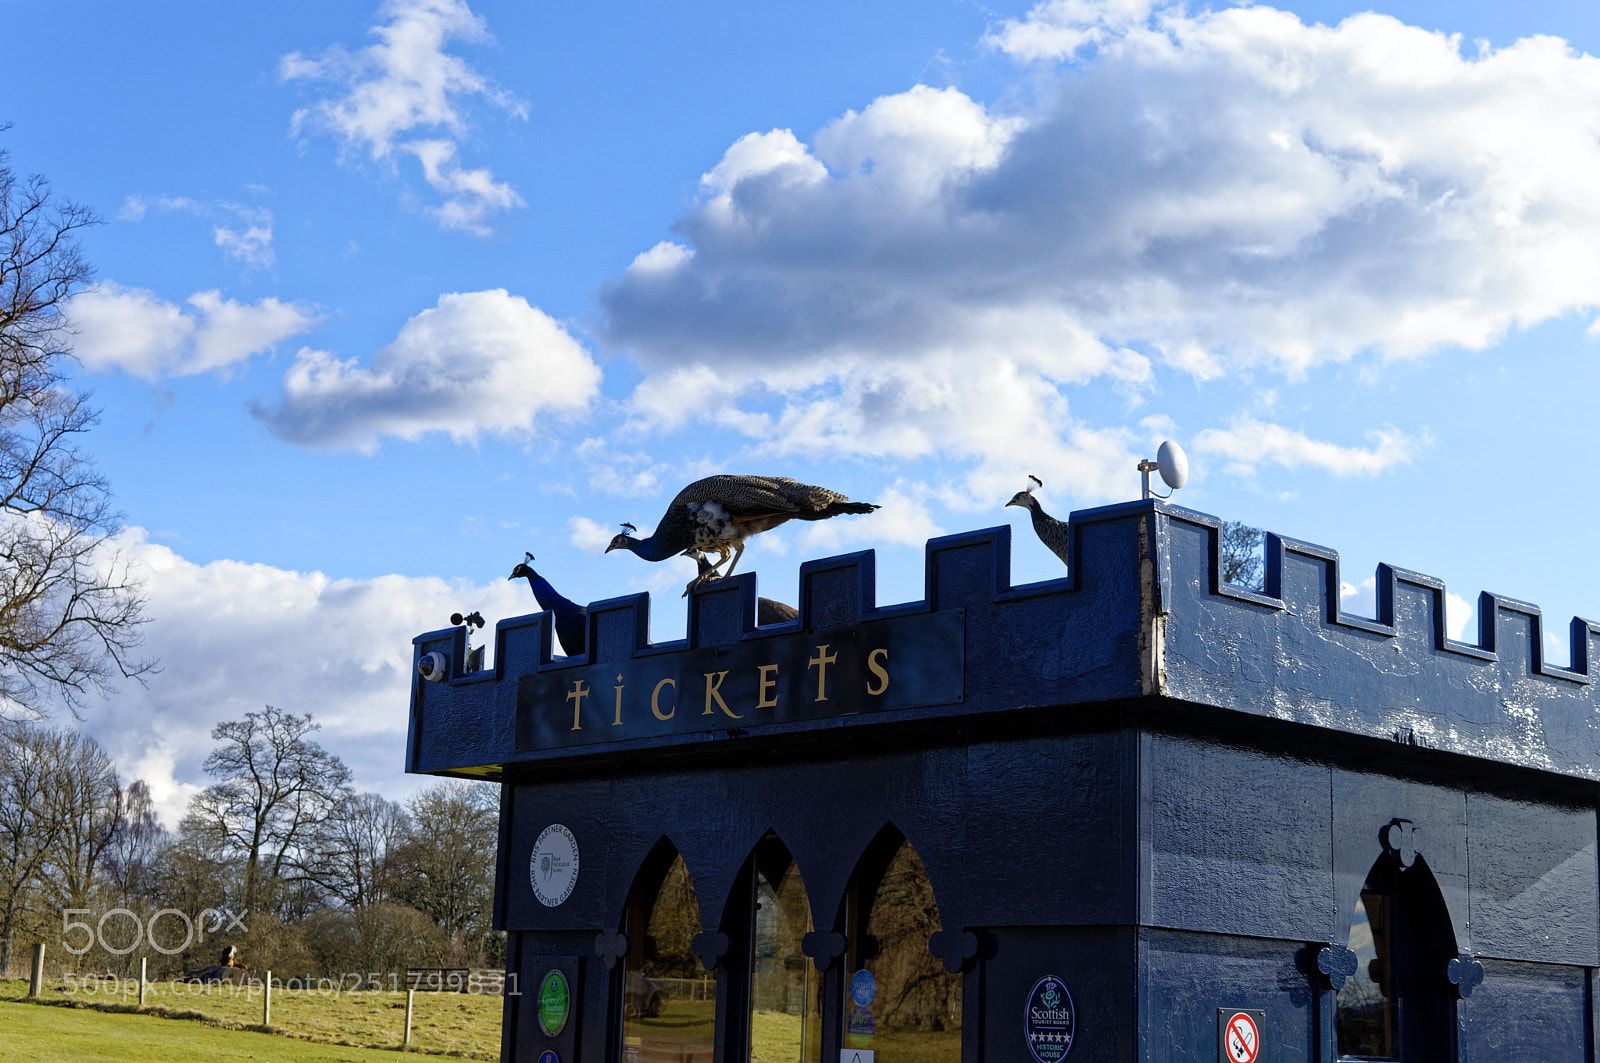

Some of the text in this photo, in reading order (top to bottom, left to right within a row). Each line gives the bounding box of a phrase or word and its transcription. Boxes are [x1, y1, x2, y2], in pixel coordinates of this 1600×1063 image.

[537, 825, 563, 845] PARTNER
[563, 828, 579, 861] GARDEN
[535, 888, 559, 907] PARTNER
[560, 868, 578, 904] GARDEN
[1031, 1007, 1069, 1020] Scottish
[1036, 1043, 1064, 1051] HISTORIC
